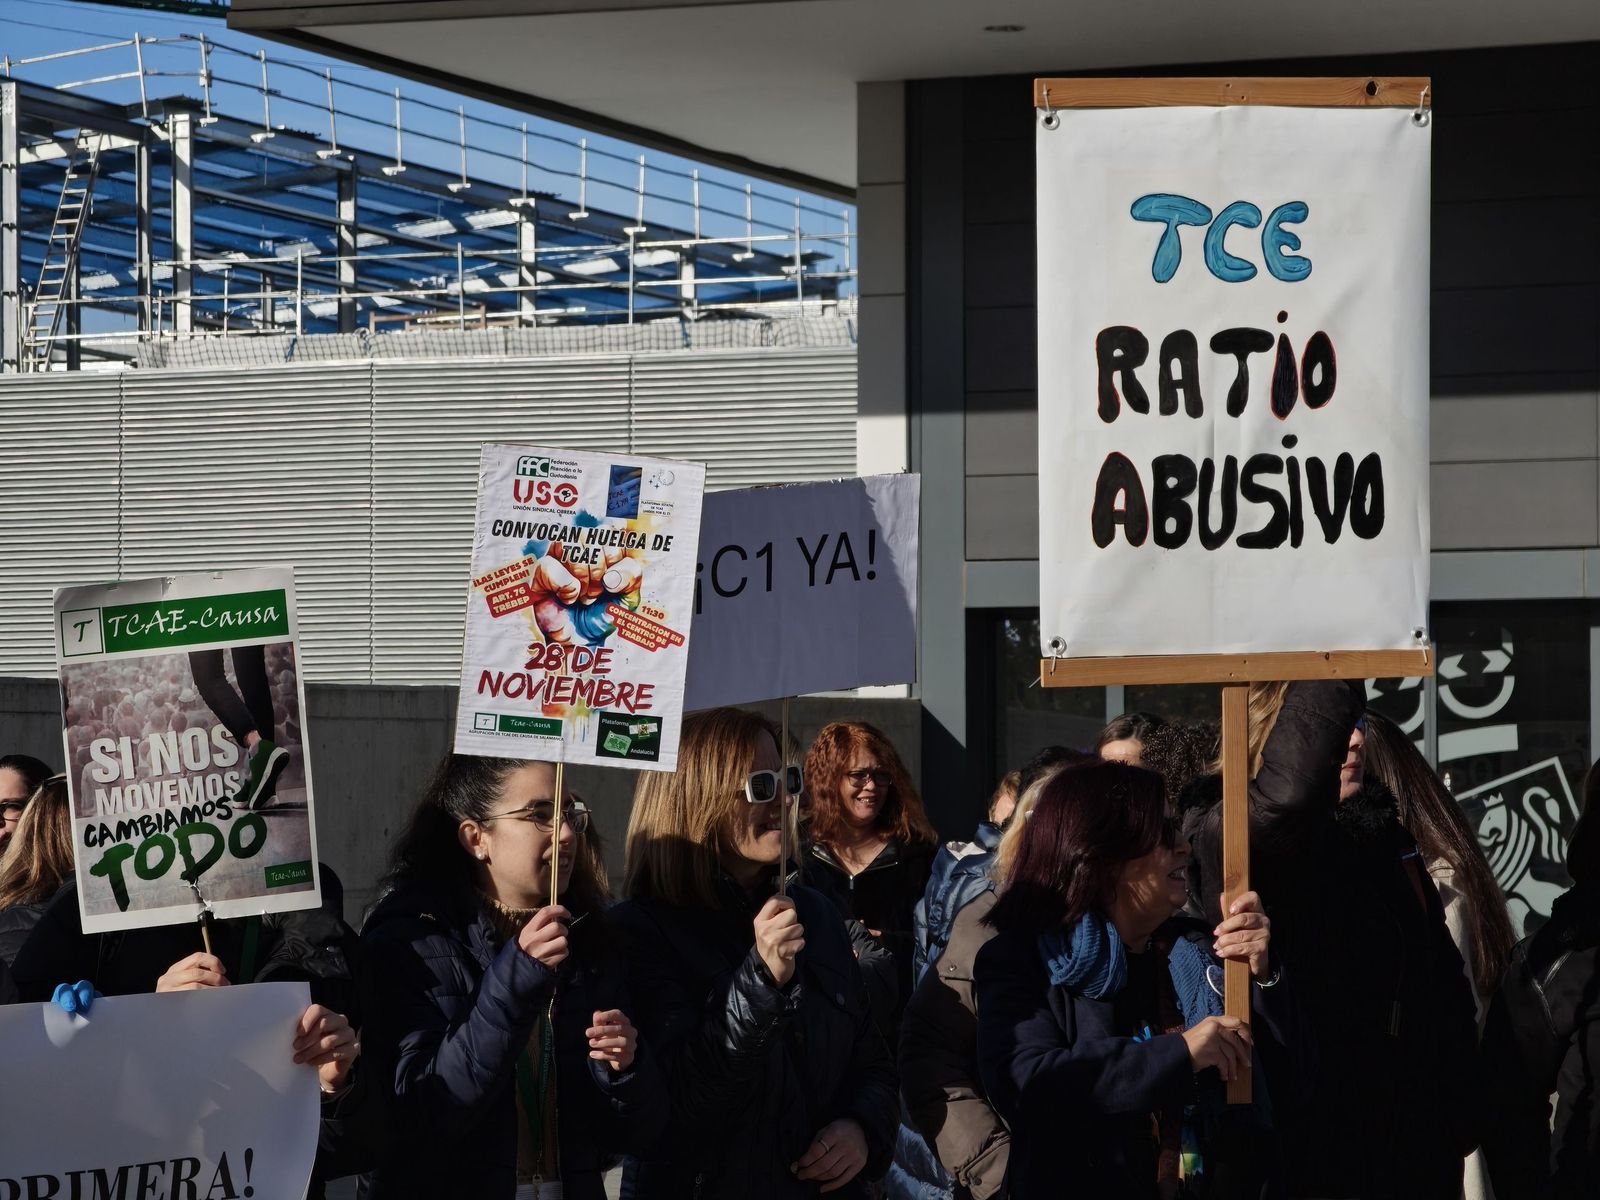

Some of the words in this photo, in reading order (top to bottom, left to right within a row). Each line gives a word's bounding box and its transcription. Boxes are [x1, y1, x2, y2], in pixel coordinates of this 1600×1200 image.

[1130, 193, 1312, 283] TCE
[513, 479, 579, 508] USO
[491, 519, 581, 543] CONVOCAN
[585, 528, 647, 550] HUELGA
[651, 534, 674, 552] DE
[562, 545, 601, 565] TCAE
[472, 574, 494, 588] ¡LAS
[494, 562, 522, 578] LEYES
[522, 557, 534, 566] SE
[696, 542, 773, 615] ¡C1
[796, 529, 876, 587] YA!
[492, 591, 513, 604] ART.
[514, 587, 526, 596] 76
[493, 595, 530, 614] TREBEP
[108, 604, 280, 638] TCAE-Causa
[641, 605, 665, 620] 11:30
[73, 619, 93, 642] T
[616, 618, 626, 627] EL
[626, 622, 656, 640] CENTRO
[656, 636, 667, 645] DE
[621, 628, 656, 648] TRABAJO
[670, 634, 682, 643] EN
[524, 642, 565, 672] 28
[570, 646, 615, 675] DE
[477, 670, 655, 714] NOVIEMBRE
[601, 718, 630, 727] Plataforma
[89, 735, 135, 784] SI
[149, 723, 240, 777] NOS
[95, 770, 242, 817] MOVEMOS
[83, 795, 233, 847] CAMBIAMOS
[89, 812, 268, 912] TODO
